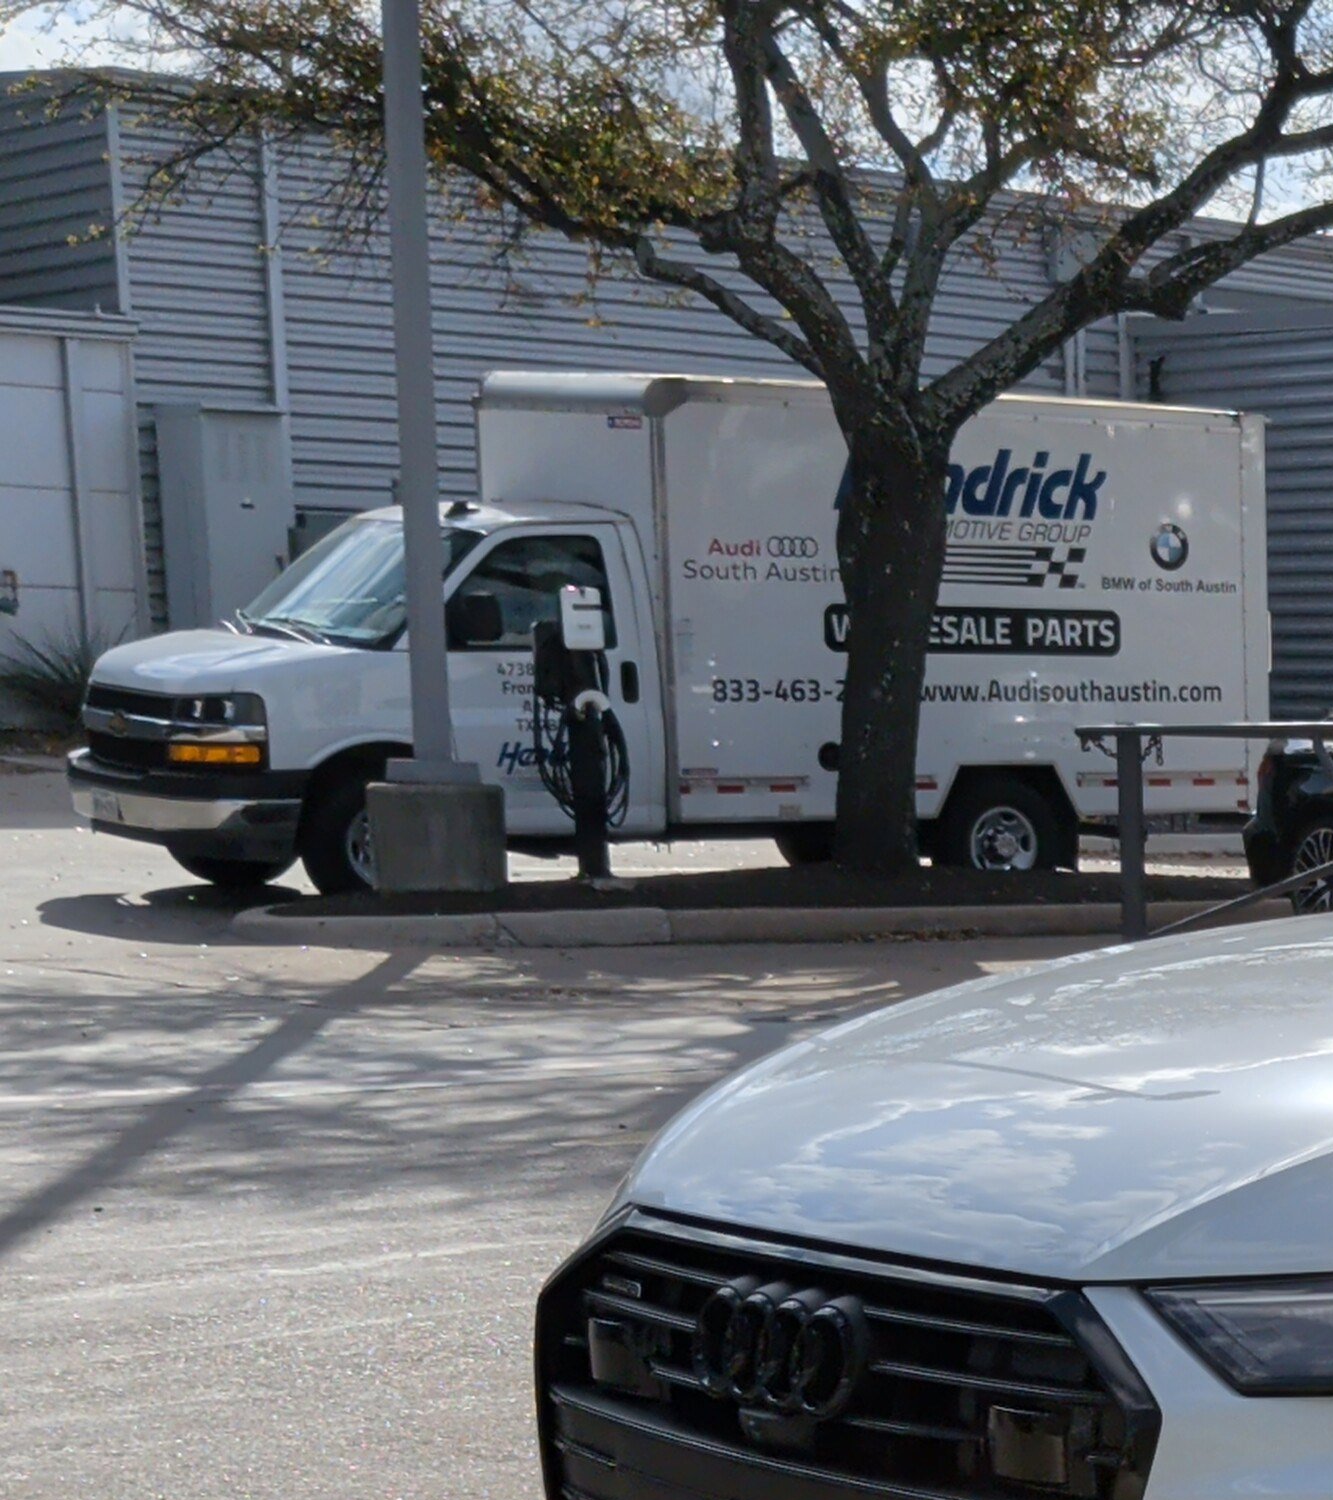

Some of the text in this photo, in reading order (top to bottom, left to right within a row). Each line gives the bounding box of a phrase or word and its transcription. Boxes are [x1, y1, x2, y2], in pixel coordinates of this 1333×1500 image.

[1018, 523, 1092, 543] GROUP
[708, 538, 761, 557] Audi
[683, 559, 841, 583] South Austin
[1101, 577, 1135, 591] BMW
[1138, 578, 1152, 591] of
[1155, 578, 1193, 593] South
[1196, 579, 1237, 594] Austin
[831, 613, 1116, 648] WESALE PARTS
[712, 678, 1222, 702] 833-463-2 www.Audisouthaustin.com
